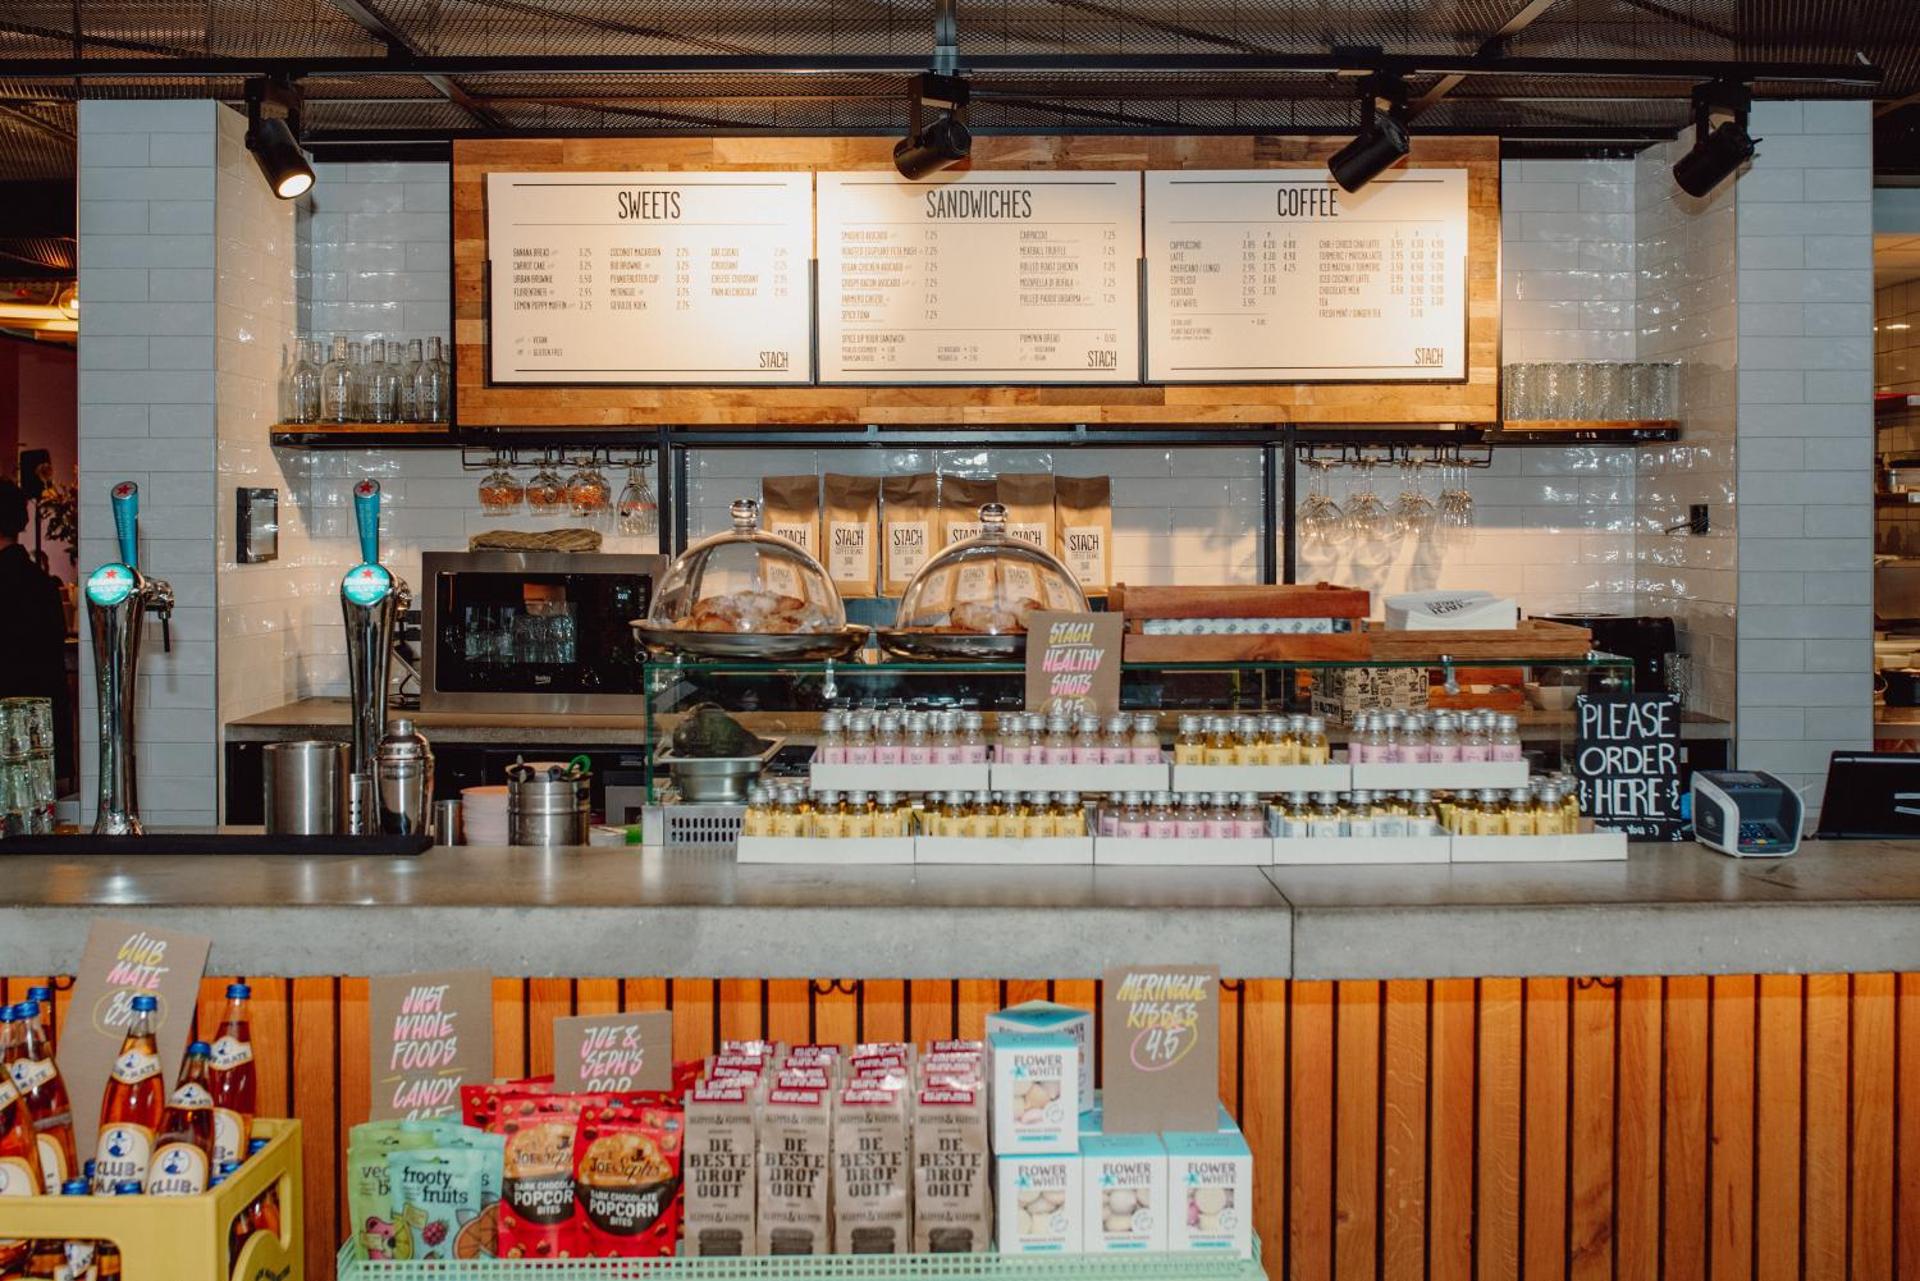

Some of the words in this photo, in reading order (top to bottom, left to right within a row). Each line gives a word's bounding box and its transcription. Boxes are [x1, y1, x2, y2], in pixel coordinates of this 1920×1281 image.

[618, 191, 681, 219] SWEETS
[927, 190, 1032, 218] SANDWICHES
[1277, 188, 1339, 217] COFFEE
[759, 352, 788, 368] STACH
[1088, 350, 1117, 367] STACH
[1414, 348, 1444, 365] STACH
[835, 528, 864, 546] STACH
[894, 528, 922, 546] STACH
[1070, 534, 1099, 551] STACH
[1049, 622, 1095, 644] STACH
[1042, 649, 1104, 673] HEALTHY
[1050, 673, 1093, 695] SHOTS
[1583, 702, 1676, 739] PLEASE
[1580, 743, 1677, 775] ORDER
[1594, 778, 1665, 816] HERE
[106, 960, 170, 988] MATE
[1116, 973, 1212, 1002] MERINGUE
[402, 984, 450, 1014] JUST
[1126, 1002, 1199, 1030] KISSES
[394, 1011, 458, 1041] WHOLE
[581, 1025, 625, 1058] JOE
[622, 1024, 642, 1049] &
[1146, 1028, 1187, 1061] 4.5
[390, 1036, 458, 1070] FOODS
[1014, 1055, 1062, 1066] FLOWER
[580, 1048, 644, 1080] SEPH'S
[1028, 1067, 1062, 1076] WHITE
[392, 1076, 462, 1108] CANDY
[709, 1138, 733, 1152] DE
[784, 1138, 807, 1152] DE
[859, 1137, 884, 1151] DE
[939, 1138, 964, 1152] DE
[690, 1154, 751, 1168] BESTE
[765, 1154, 825, 1169] BESTE
[840, 1152, 902, 1168] BESTE
[920, 1152, 982, 1168] BESTE
[1188, 1162, 1236, 1174] FLOWER
[696, 1169, 746, 1183] DROP
[770, 1168, 819, 1183] DROP
[846, 1167, 897, 1182] DROP
[926, 1168, 976, 1182] DROP
[1018, 1165, 1066, 1176] FLOWER
[1103, 1163, 1151, 1174] FLOWER
[402, 1166, 453, 1189] frooty
[536, 1180, 575, 1191] CHOCOLA
[1032, 1176, 1067, 1187] WHITE
[1117, 1174, 1151, 1185] WHITE
[1202, 1174, 1236, 1184] WHITE
[422, 1186, 469, 1204] fruits
[514, 1190, 574, 1206] POPCOR
[610, 1191, 658, 1203] CHOCOLATE
[698, 1184, 742, 1198] OOIT
[772, 1184, 815, 1198] OOIT
[849, 1182, 895, 1198] OOIT
[928, 1183, 972, 1198] OOIT
[536, 1204, 561, 1216] BITES
[590, 1198, 659, 1218] POPCORN
[610, 1216, 633, 1228] BITES
